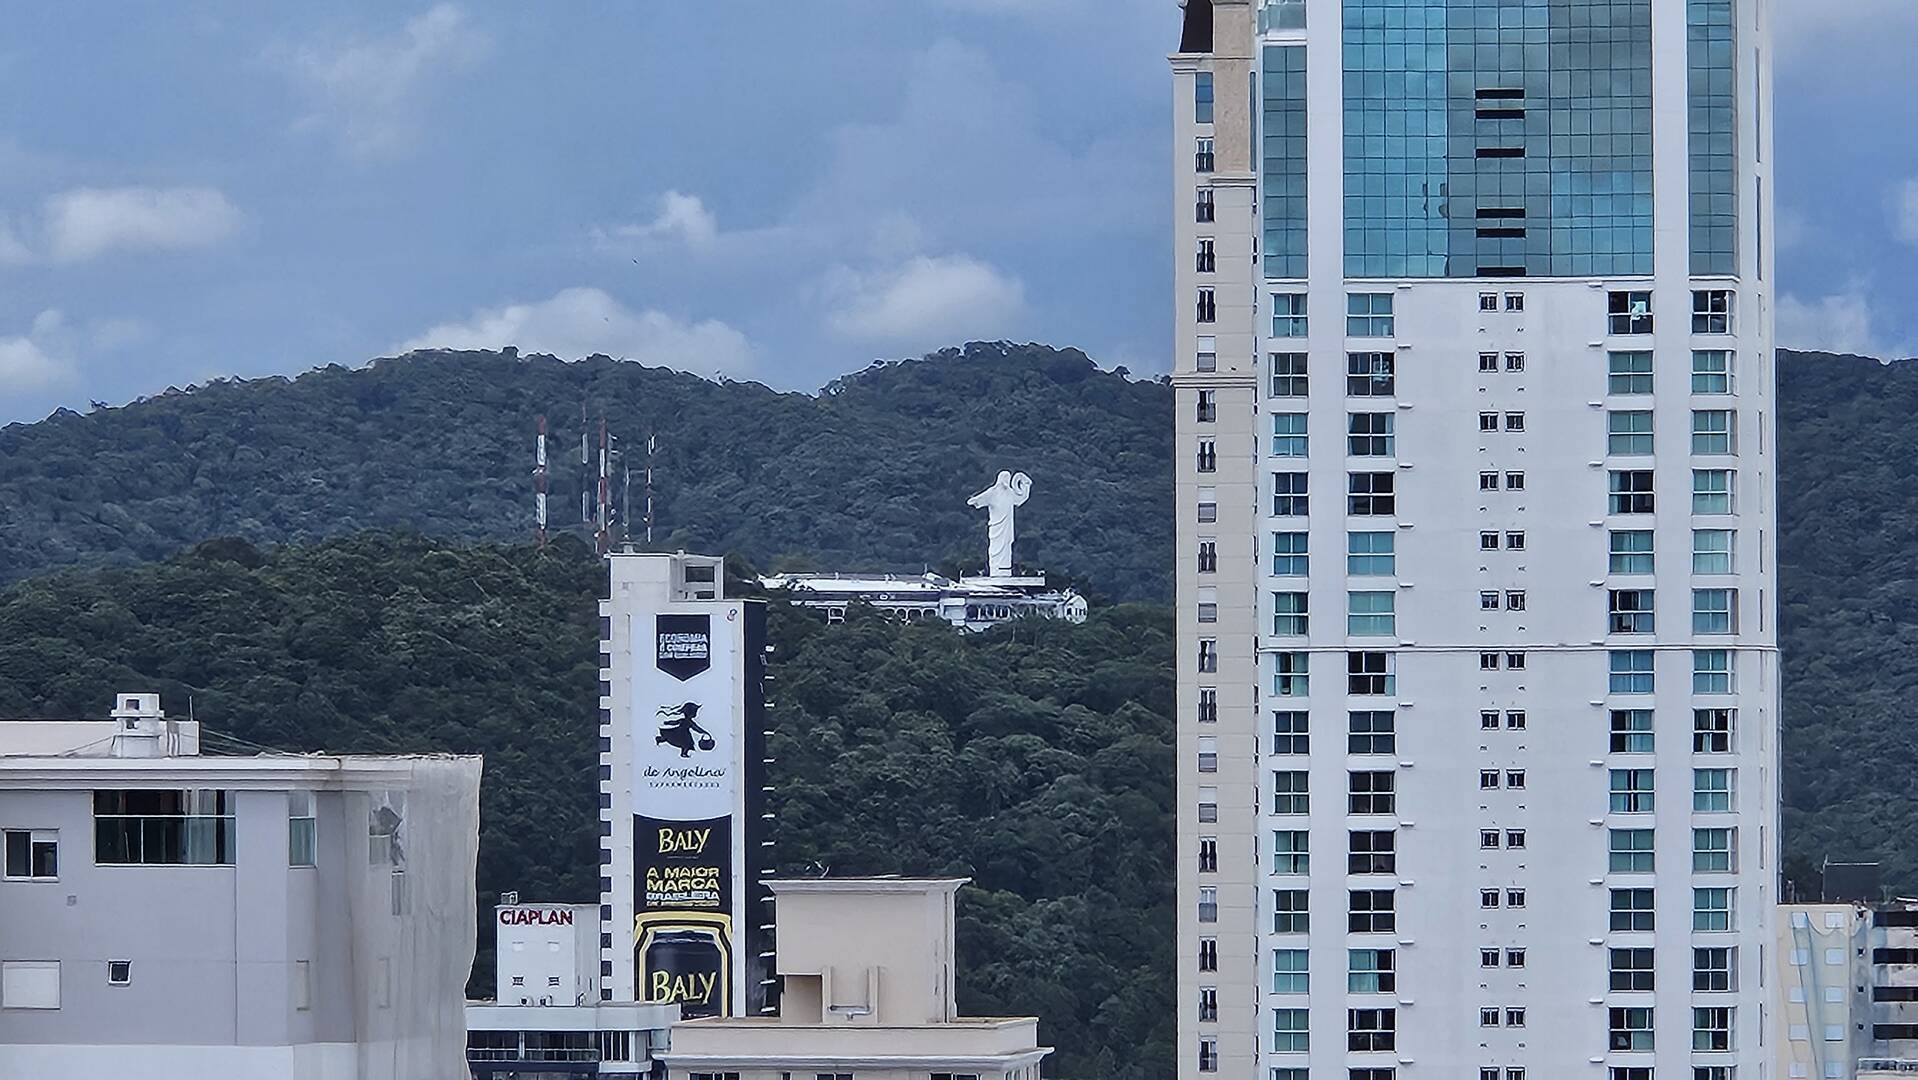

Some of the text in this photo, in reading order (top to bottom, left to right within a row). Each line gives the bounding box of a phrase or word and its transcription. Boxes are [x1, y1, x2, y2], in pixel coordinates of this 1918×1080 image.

[658, 828, 711, 854] BALY
[646, 866, 720, 879] A MAIOR
[646, 878, 720, 892] MARCA
[500, 909, 573, 925] CIAPLAN
[652, 970, 716, 1004] BALY
